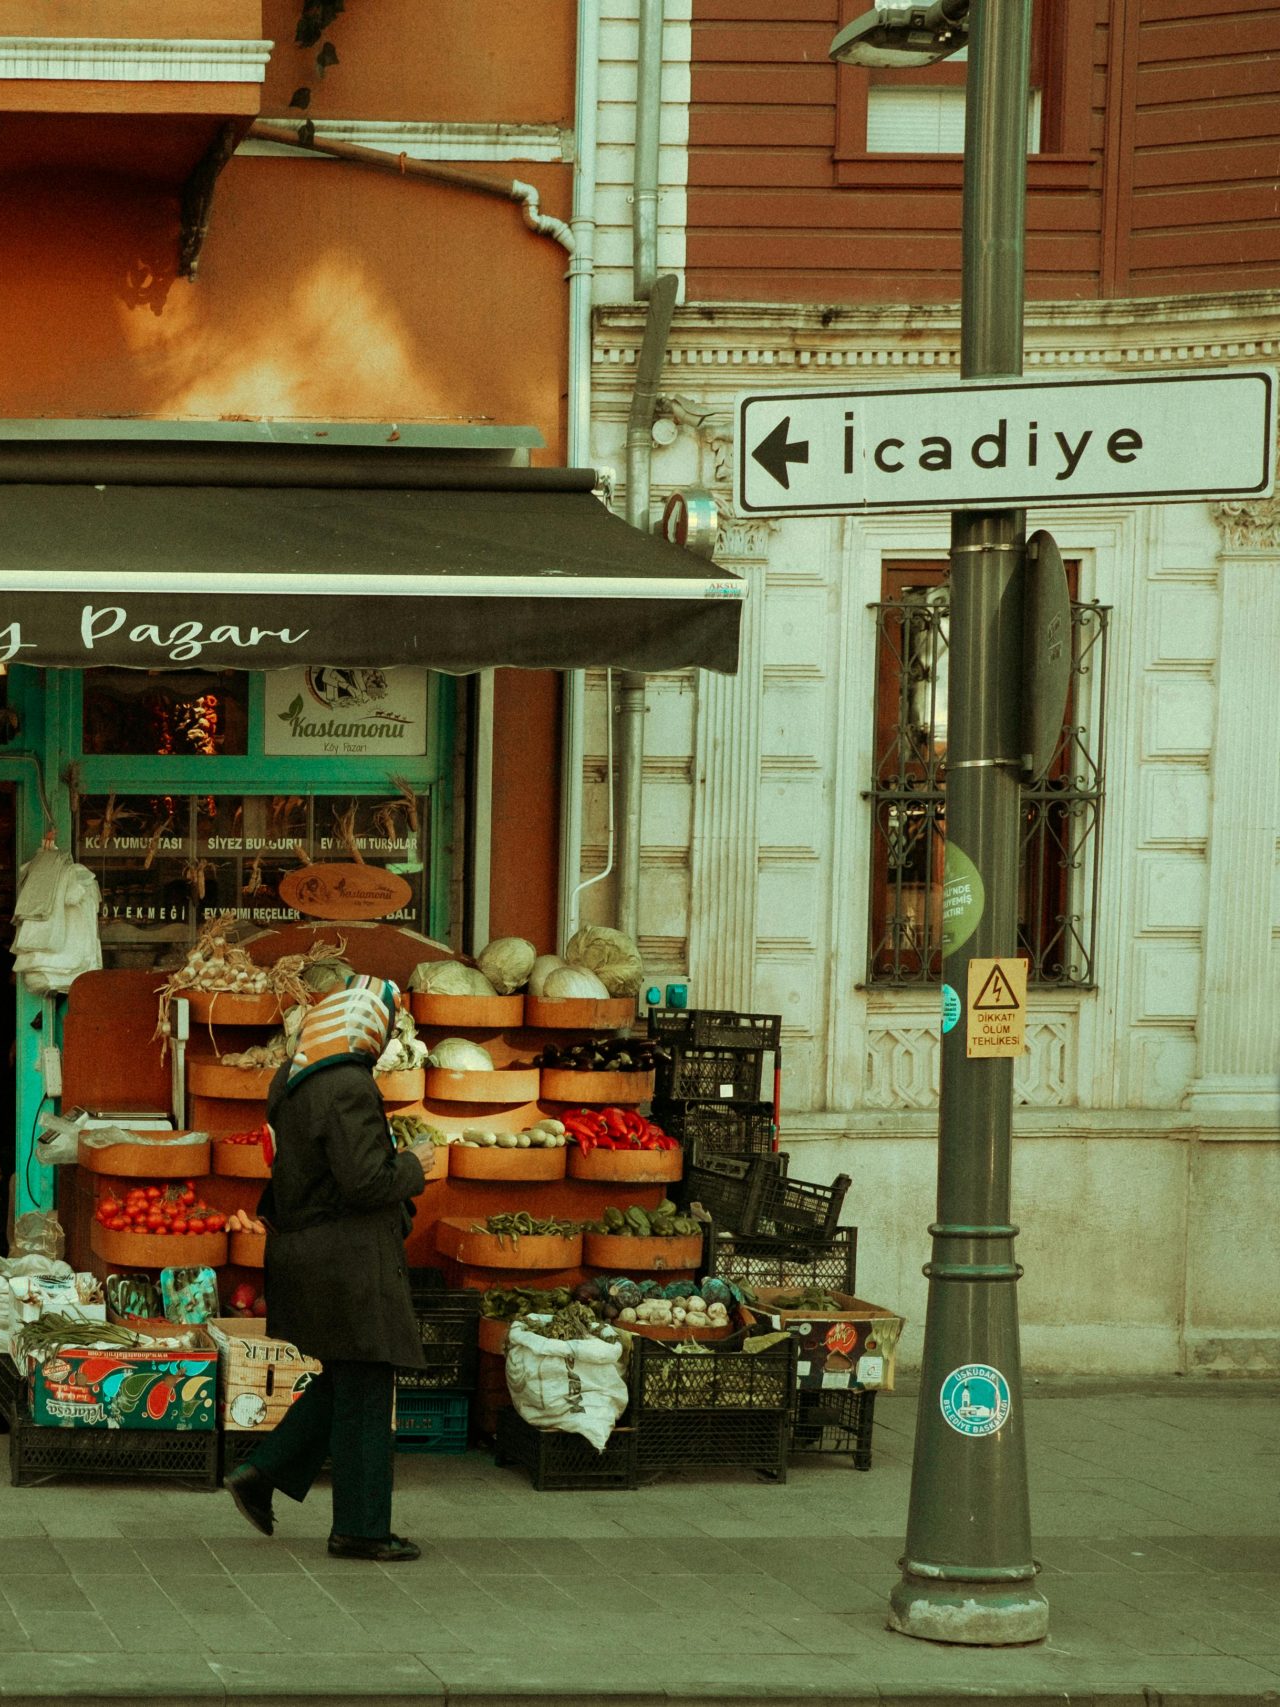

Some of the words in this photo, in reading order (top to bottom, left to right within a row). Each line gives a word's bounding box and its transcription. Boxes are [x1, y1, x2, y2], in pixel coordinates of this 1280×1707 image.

[843, 411, 1144, 481] İcadiye
[80, 603, 312, 661] Pazarı
[290, 716, 405, 738] Kastamonu
[323, 742, 339, 754] Köy
[207, 835, 243, 850] SİYEZ
[320, 838, 333, 850] EV
[368, 837, 417, 852] TURŞULAR
[102, 905, 119, 917] ÖY
[125, 905, 186, 921] EKMEĞİ
[253, 907, 301, 921] REÇELLER
[386, 907, 416, 920] BALI
[977, 1012, 1016, 1023] DİKKAT!
[982, 1022, 1011, 1034] ÖLÜM
[972, 1034, 1020, 1047] TEHLİKESİ
[954, 1367, 997, 1382] ÜSKÜDAR
[943, 1399, 970, 1432] BELEDİYE
